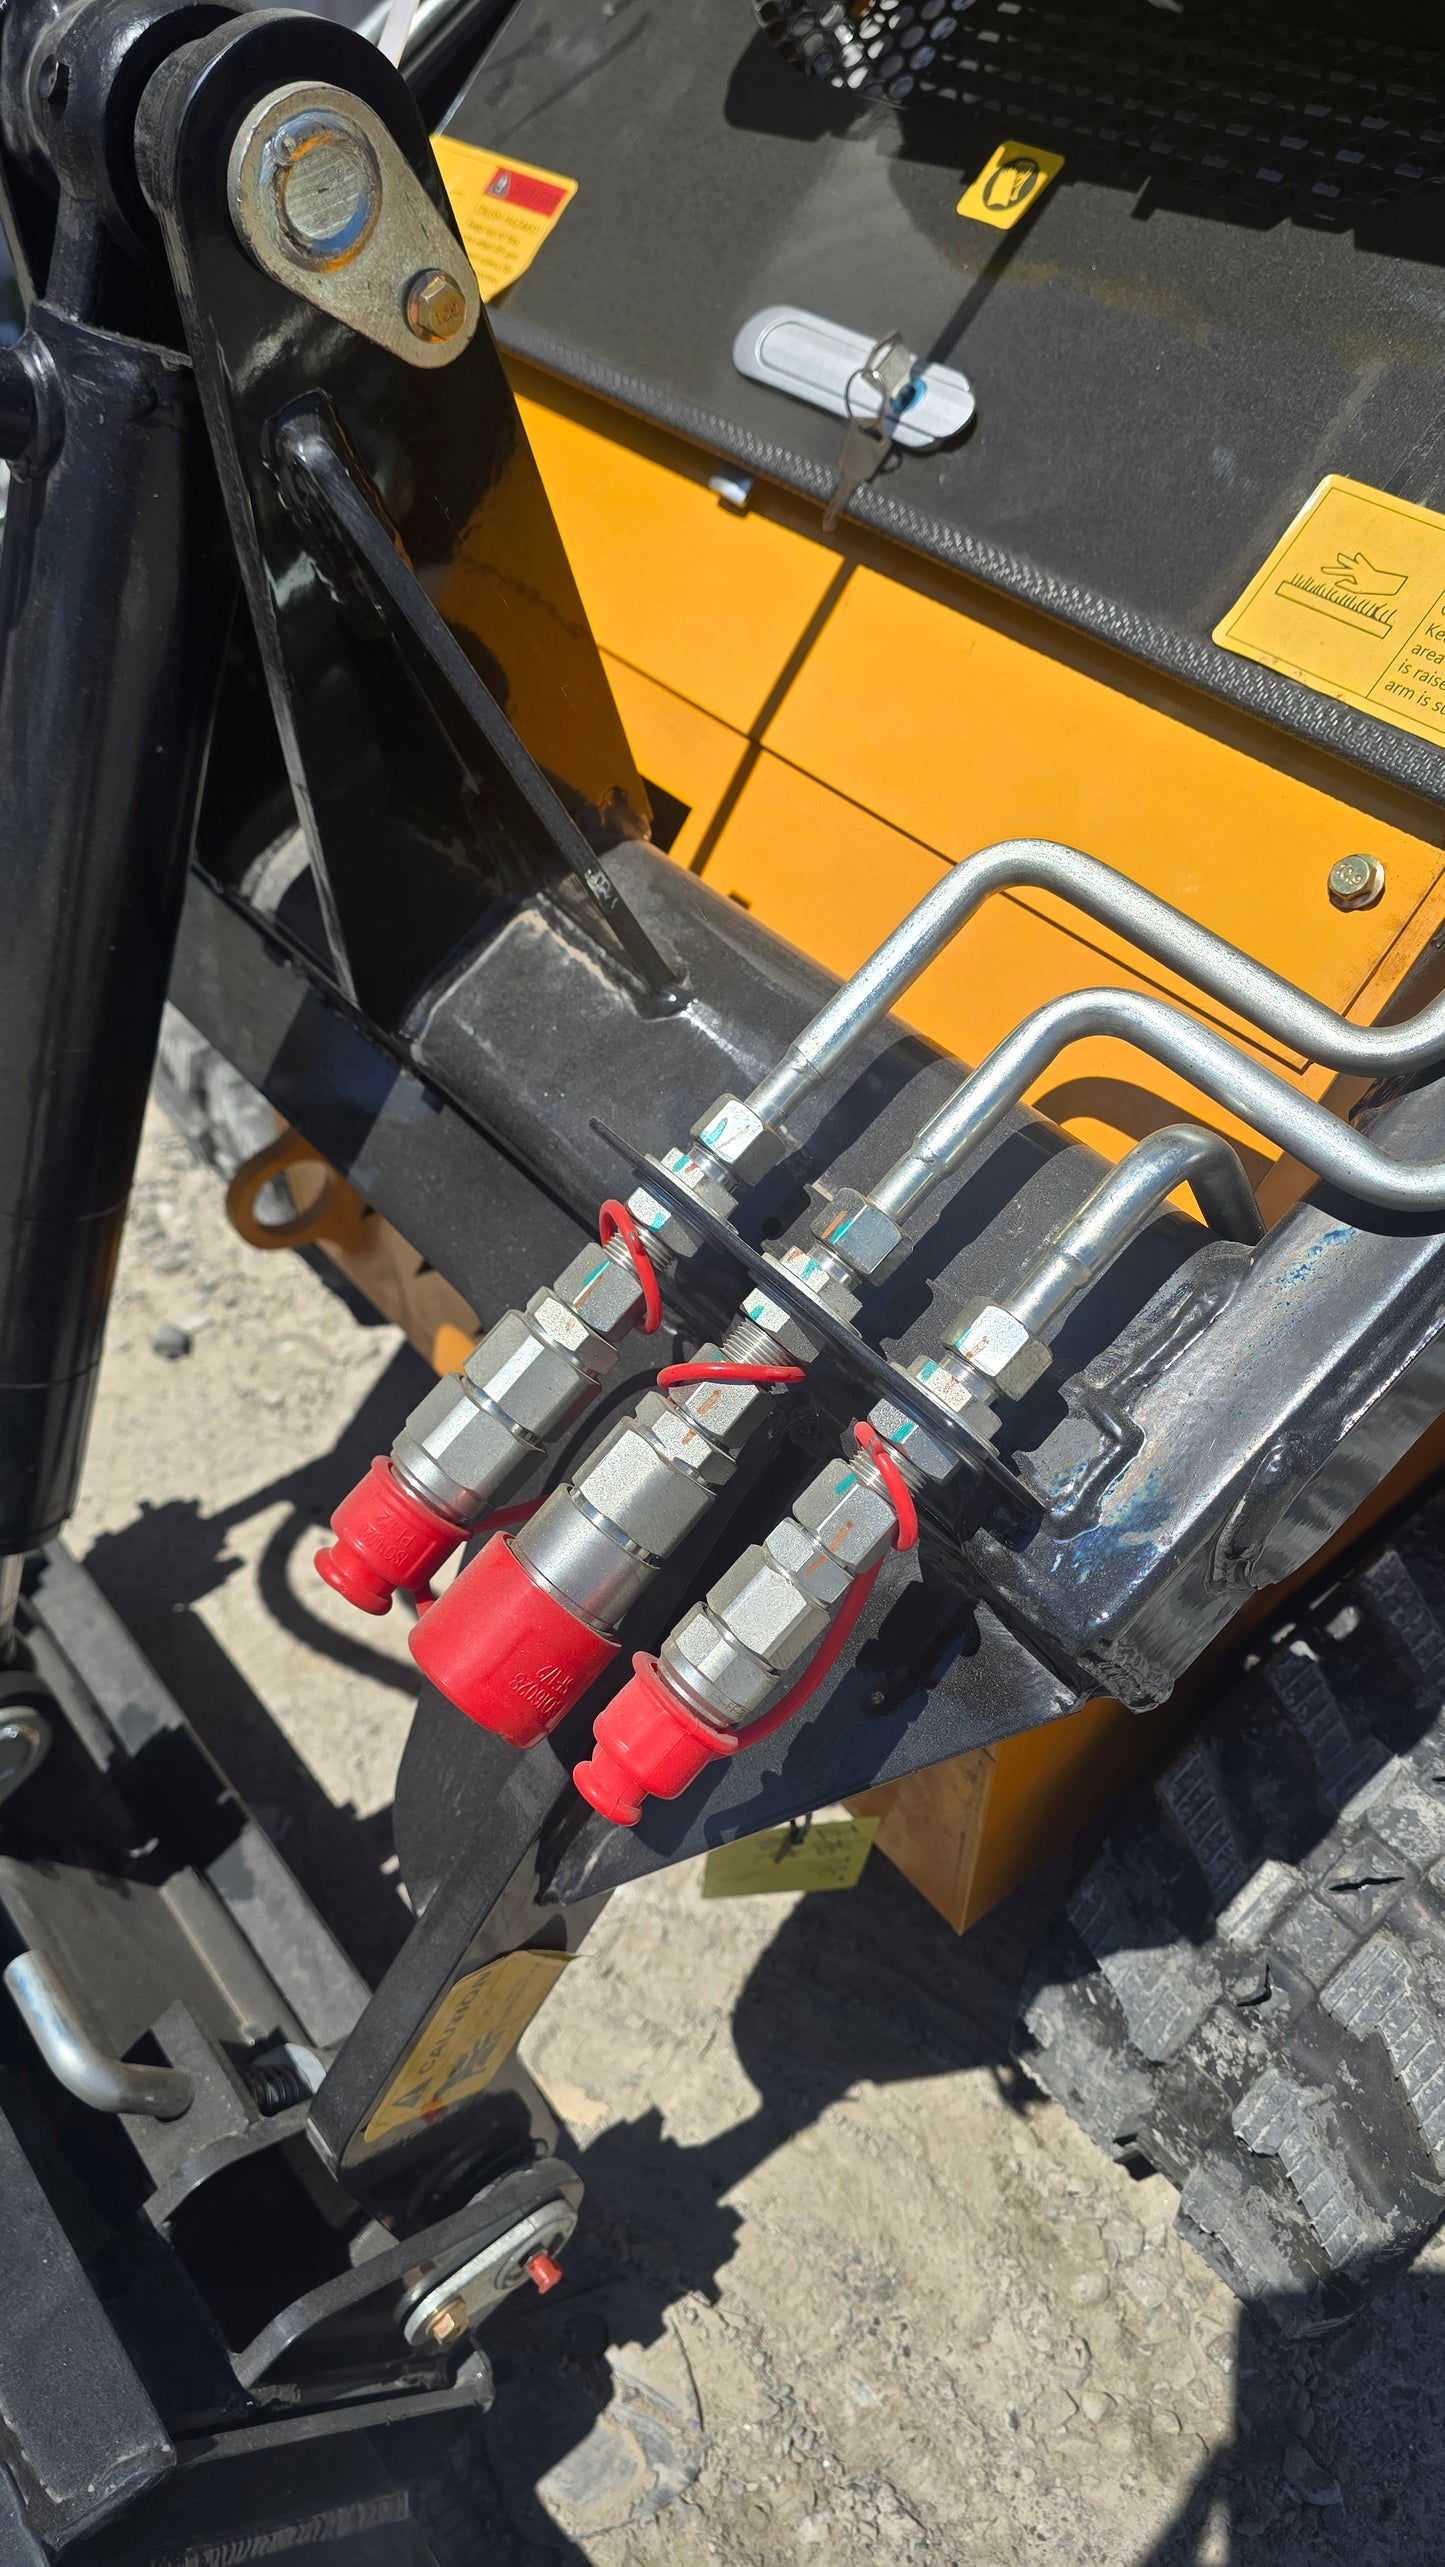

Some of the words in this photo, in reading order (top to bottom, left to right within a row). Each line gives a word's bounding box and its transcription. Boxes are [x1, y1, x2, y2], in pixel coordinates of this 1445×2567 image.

[1425, 622, 1445, 643] Ke
[1411, 644, 1445, 665] area
[1397, 658, 1412, 674] is
[1384, 680, 1415, 701] arm
[1416, 690, 1431, 707] is
[418, 1970, 492, 2075] CAUTION
